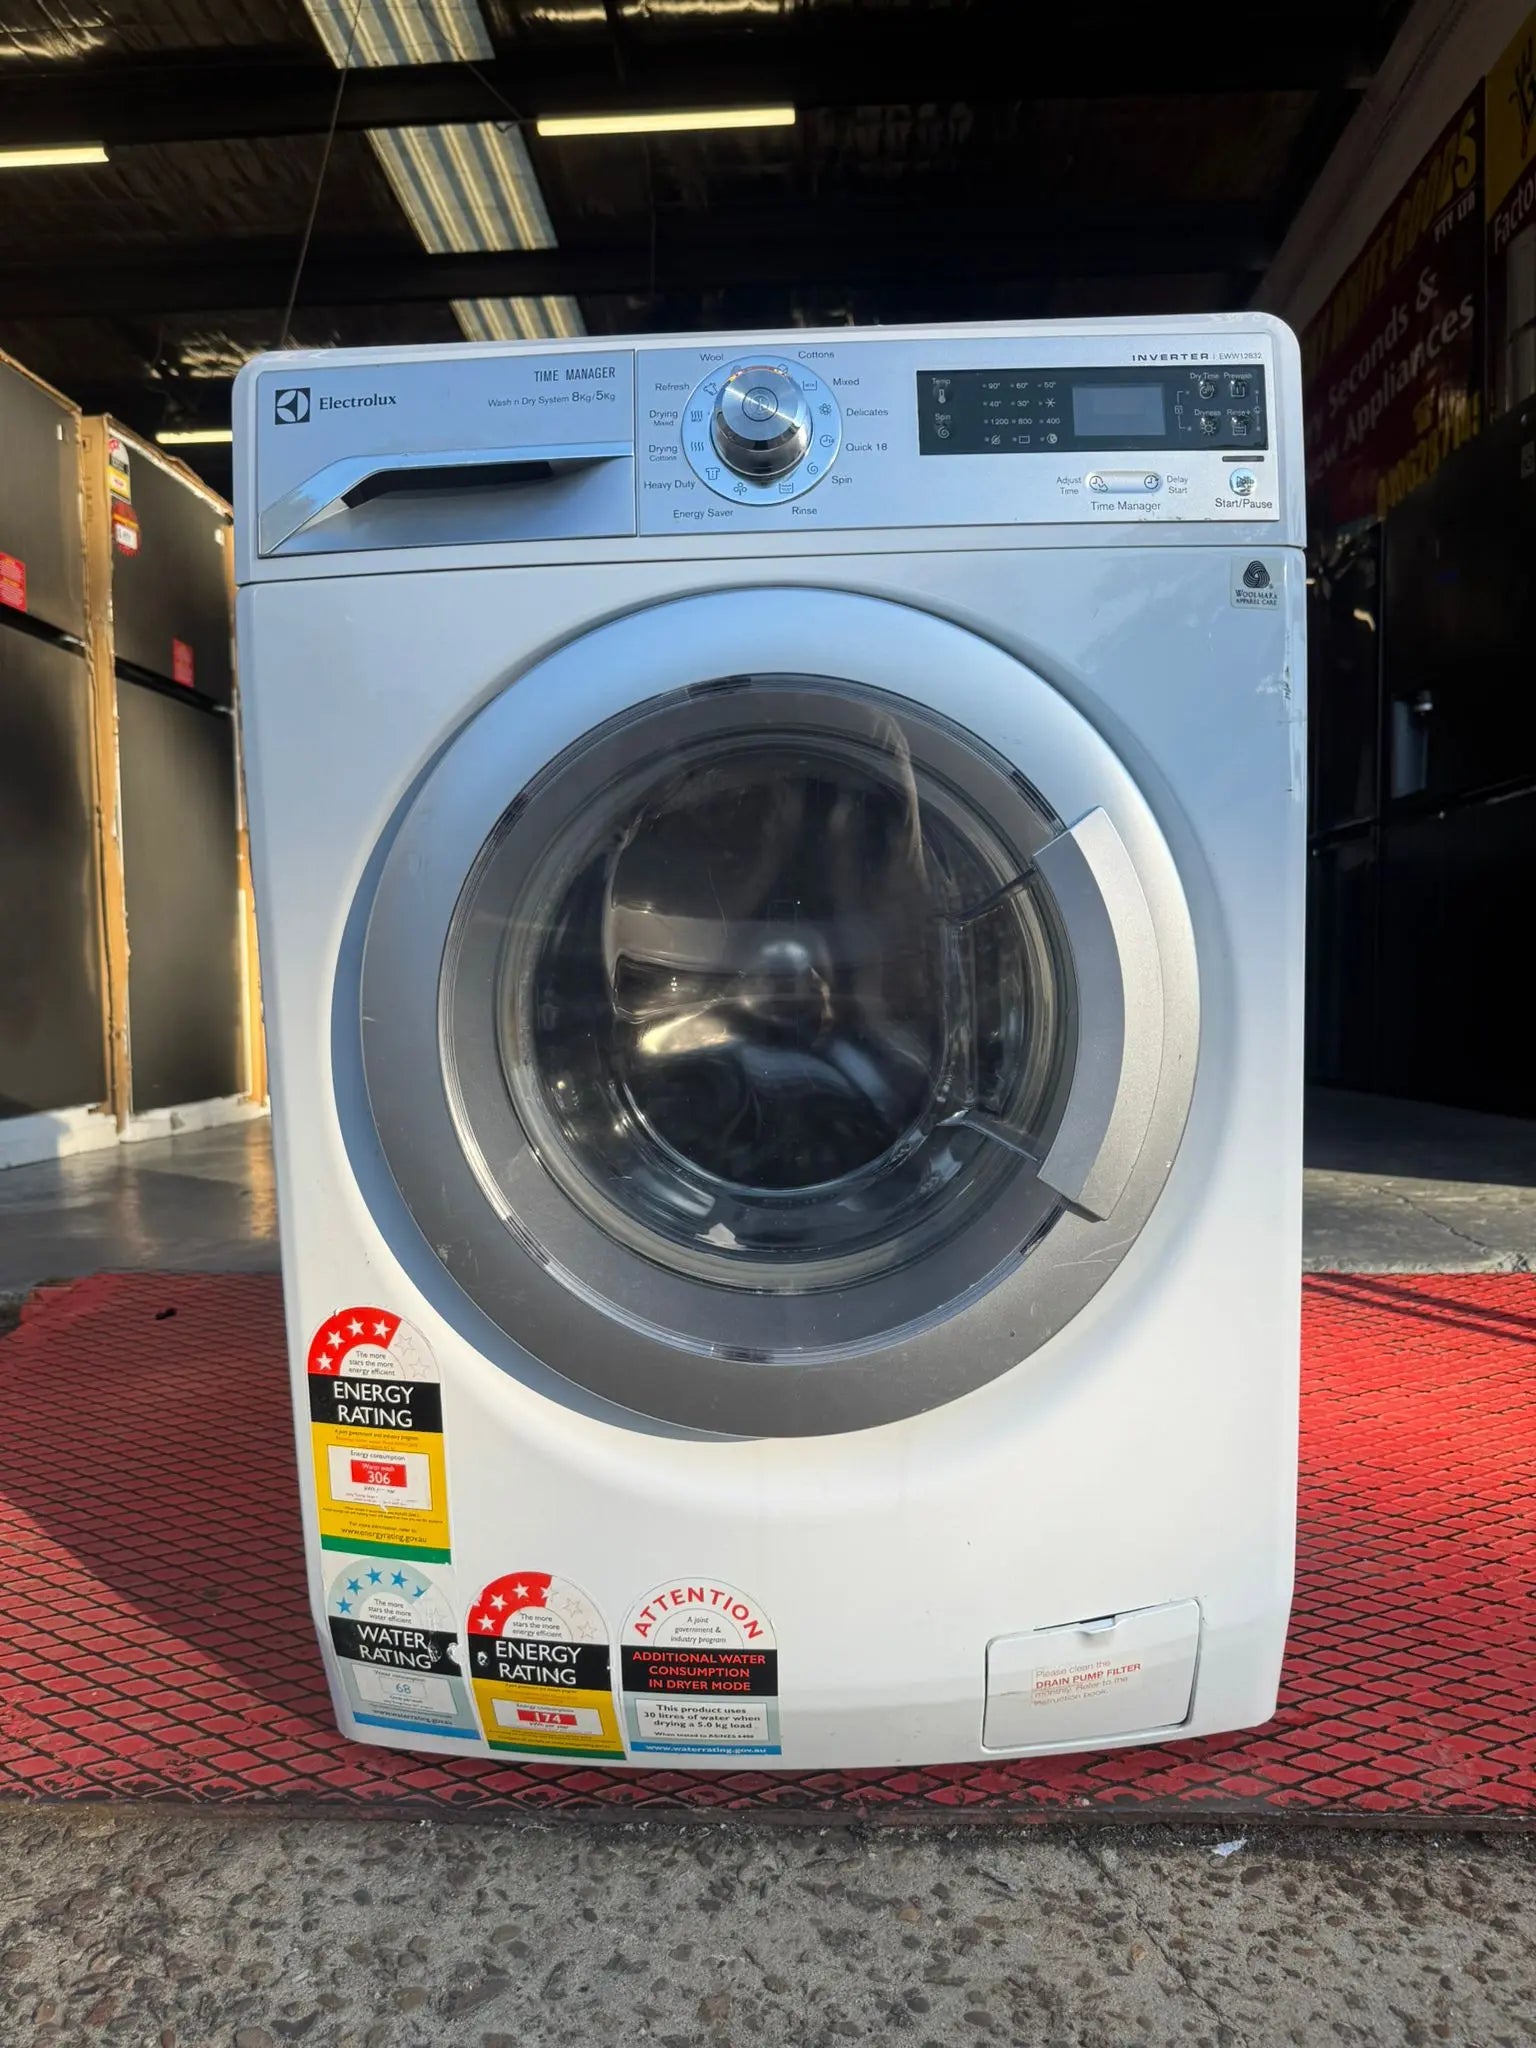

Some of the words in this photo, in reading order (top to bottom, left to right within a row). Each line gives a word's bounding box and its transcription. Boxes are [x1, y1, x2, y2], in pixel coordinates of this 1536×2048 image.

[1494, 172, 1536, 256] Facto
[1328, 303, 1410, 420] Seconds
[1415, 265, 1440, 313] &
[700, 353, 724, 361] Wool
[798, 351, 835, 359] Cottons
[1132, 353, 1209, 362] INVERTER
[534, 370, 559, 382] TIME
[565, 367, 616, 381] MANAGER
[1189, 372, 1201, 380] Dry
[1203, 371, 1219, 379] Time
[1343, 293, 1476, 453] Appliances
[833, 378, 860, 386] Mixed
[655, 383, 690, 392] Refresh
[319, 393, 397, 411] Electrolux
[488, 399, 512, 407] Wash
[521, 397, 536, 407] Dry
[538, 395, 570, 406] System
[649, 410, 679, 419] Drying
[846, 408, 889, 417] Delicates
[935, 413, 951, 422] Spin
[1045, 417, 1061, 425] 400
[648, 445, 678, 455] Drying
[845, 443, 873, 452] Quick
[876, 443, 888, 451] 18
[831, 475, 853, 485] Spin
[1056, 476, 1081, 486] Adjust
[1167, 475, 1188, 485] Delay
[643, 480, 672, 491] Heavy
[674, 480, 696, 489] Duty
[1168, 486, 1187, 494] Start
[1060, 487, 1079, 495] Time
[1090, 501, 1115, 511] Time
[1117, 501, 1161, 513] Manager
[1215, 498, 1273, 509] Start/Pause
[672, 509, 705, 520] Energy
[707, 508, 733, 518] Saver
[792, 506, 818, 515] Rinse
[356, 1350, 368, 1358] The
[369, 1352, 387, 1360] more
[348, 1358, 364, 1366] stars
[365, 1359, 376, 1367] the
[348, 1367, 370, 1376] energy
[371, 1368, 396, 1377] efficient
[333, 1381, 415, 1405] ENERGY
[337, 1404, 413, 1428] RATING
[367, 1470, 391, 1485] 306
[374, 1598, 386, 1607] The
[368, 1605, 383, 1613] stars
[384, 1607, 394, 1615] the
[634, 1587, 764, 1639] ATTENTION
[369, 1614, 387, 1622] water
[388, 1614, 412, 1624] efficient
[520, 1613, 534, 1622] The
[534, 1615, 552, 1623] more
[693, 1617, 709, 1626] joint
[512, 1621, 529, 1629] stars
[530, 1621, 541, 1630] the
[674, 1626, 713, 1634] government
[714, 1626, 722, 1634] &
[356, 1624, 430, 1649] WATER
[512, 1628, 536, 1638] energy
[536, 1630, 562, 1639] efficient
[671, 1635, 697, 1645] industry
[698, 1636, 727, 1645] program
[359, 1644, 432, 1669] RATING
[494, 1640, 583, 1665] ENERGY
[632, 1651, 718, 1664] ADDITIONAL
[718, 1654, 767, 1665] WATER
[499, 1662, 577, 1686] RATING
[648, 1665, 750, 1678] CONSUMPTION
[1036, 1667, 1067, 1678] Please
[1069, 1664, 1093, 1674] clean
[1095, 1660, 1111, 1669] the
[1035, 1677, 1070, 1689] DRAIN
[1072, 1671, 1104, 1684] PUMP
[1106, 1663, 1142, 1678] FILTER
[649, 1679, 663, 1689] IN
[666, 1680, 709, 1690] DRYER
[711, 1681, 751, 1691] MODE
[1102, 1679, 1112, 1687] to
[1113, 1676, 1129, 1684] the
[395, 1682, 412, 1694] 68
[656, 1704, 679, 1712] This
[681, 1705, 722, 1714] product
[535, 1711, 562, 1724] 174
[658, 1712, 685, 1720] litres
[653, 1719, 687, 1729] drying
[715, 1722, 728, 1730] kg
